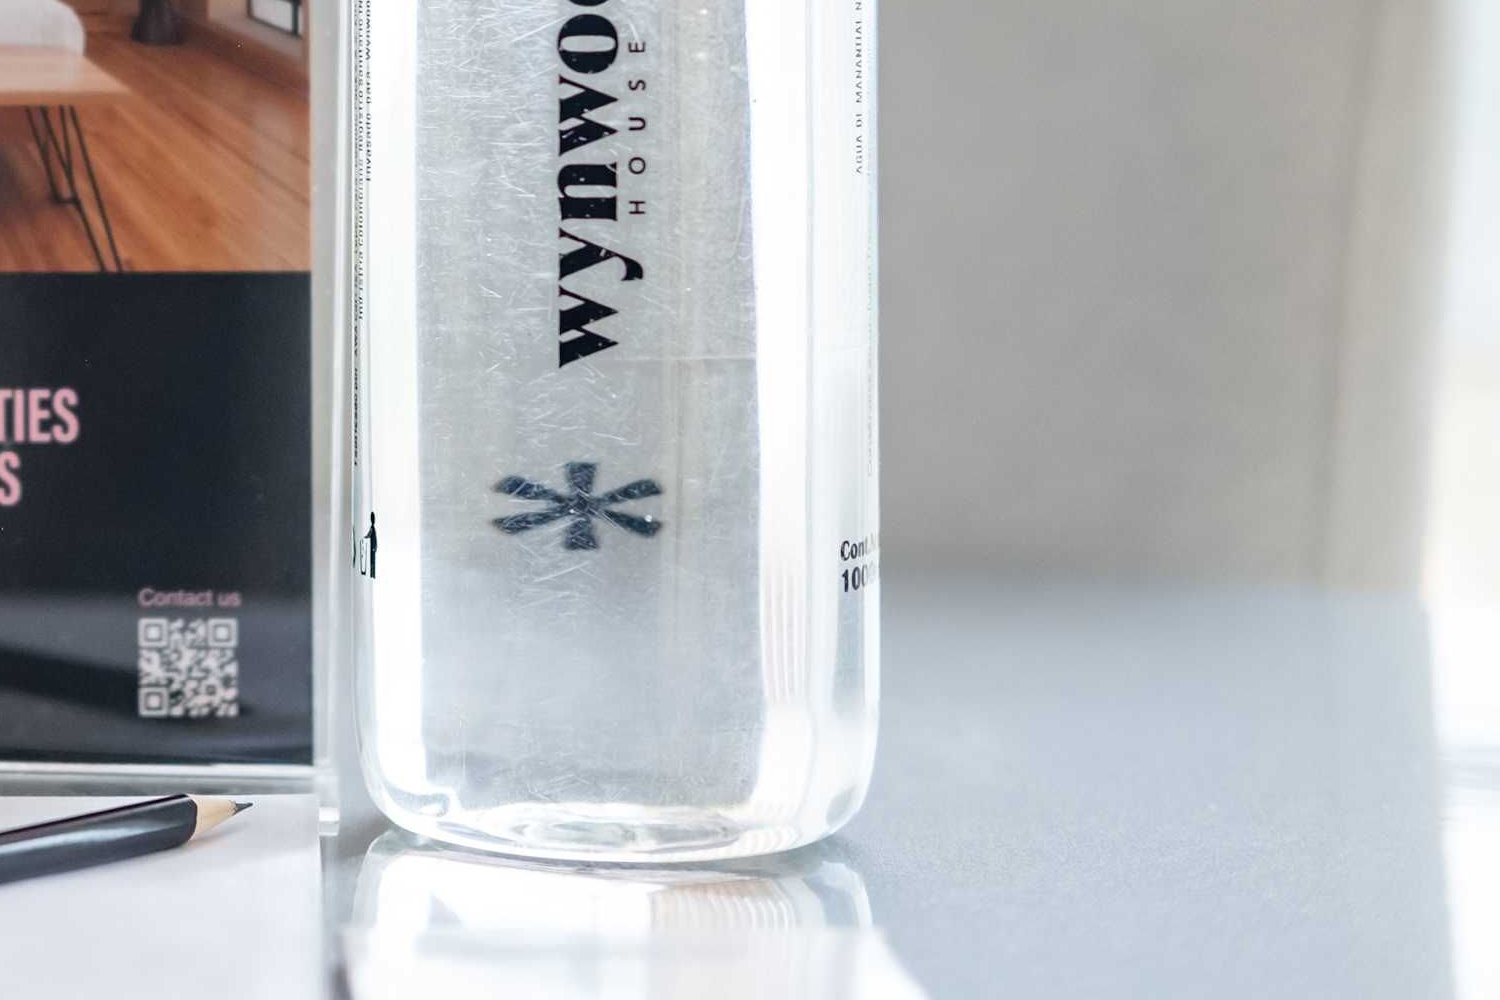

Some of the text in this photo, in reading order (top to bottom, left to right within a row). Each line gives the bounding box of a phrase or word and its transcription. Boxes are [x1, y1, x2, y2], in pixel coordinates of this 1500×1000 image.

[628, 40, 646, 216] HOUSE
[138, 588, 242, 607] Contact us
